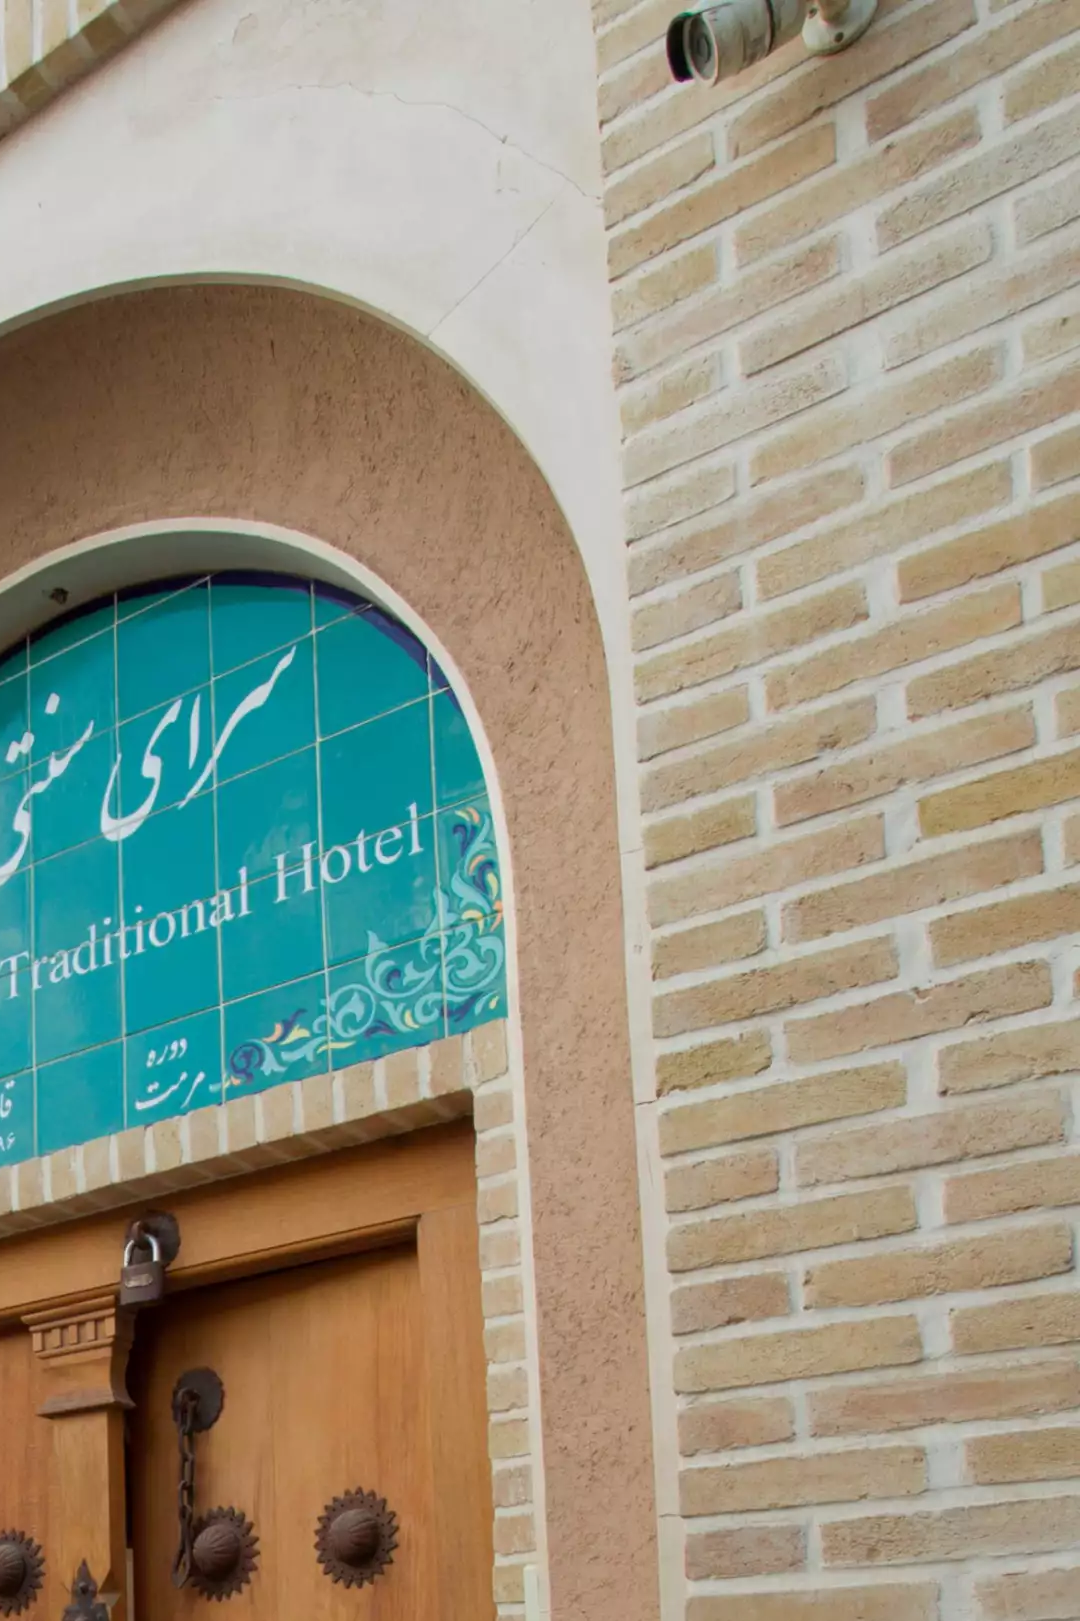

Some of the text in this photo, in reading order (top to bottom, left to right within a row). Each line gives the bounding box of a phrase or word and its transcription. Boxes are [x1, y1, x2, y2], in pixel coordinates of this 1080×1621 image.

[101, 645, 296, 841] سرای
[0, 866, 253, 999] Traditional
[273, 802, 425, 903] Hotel
[134, 1071, 206, 1111] مرمت
[146, 1038, 188, 1068] دوره
